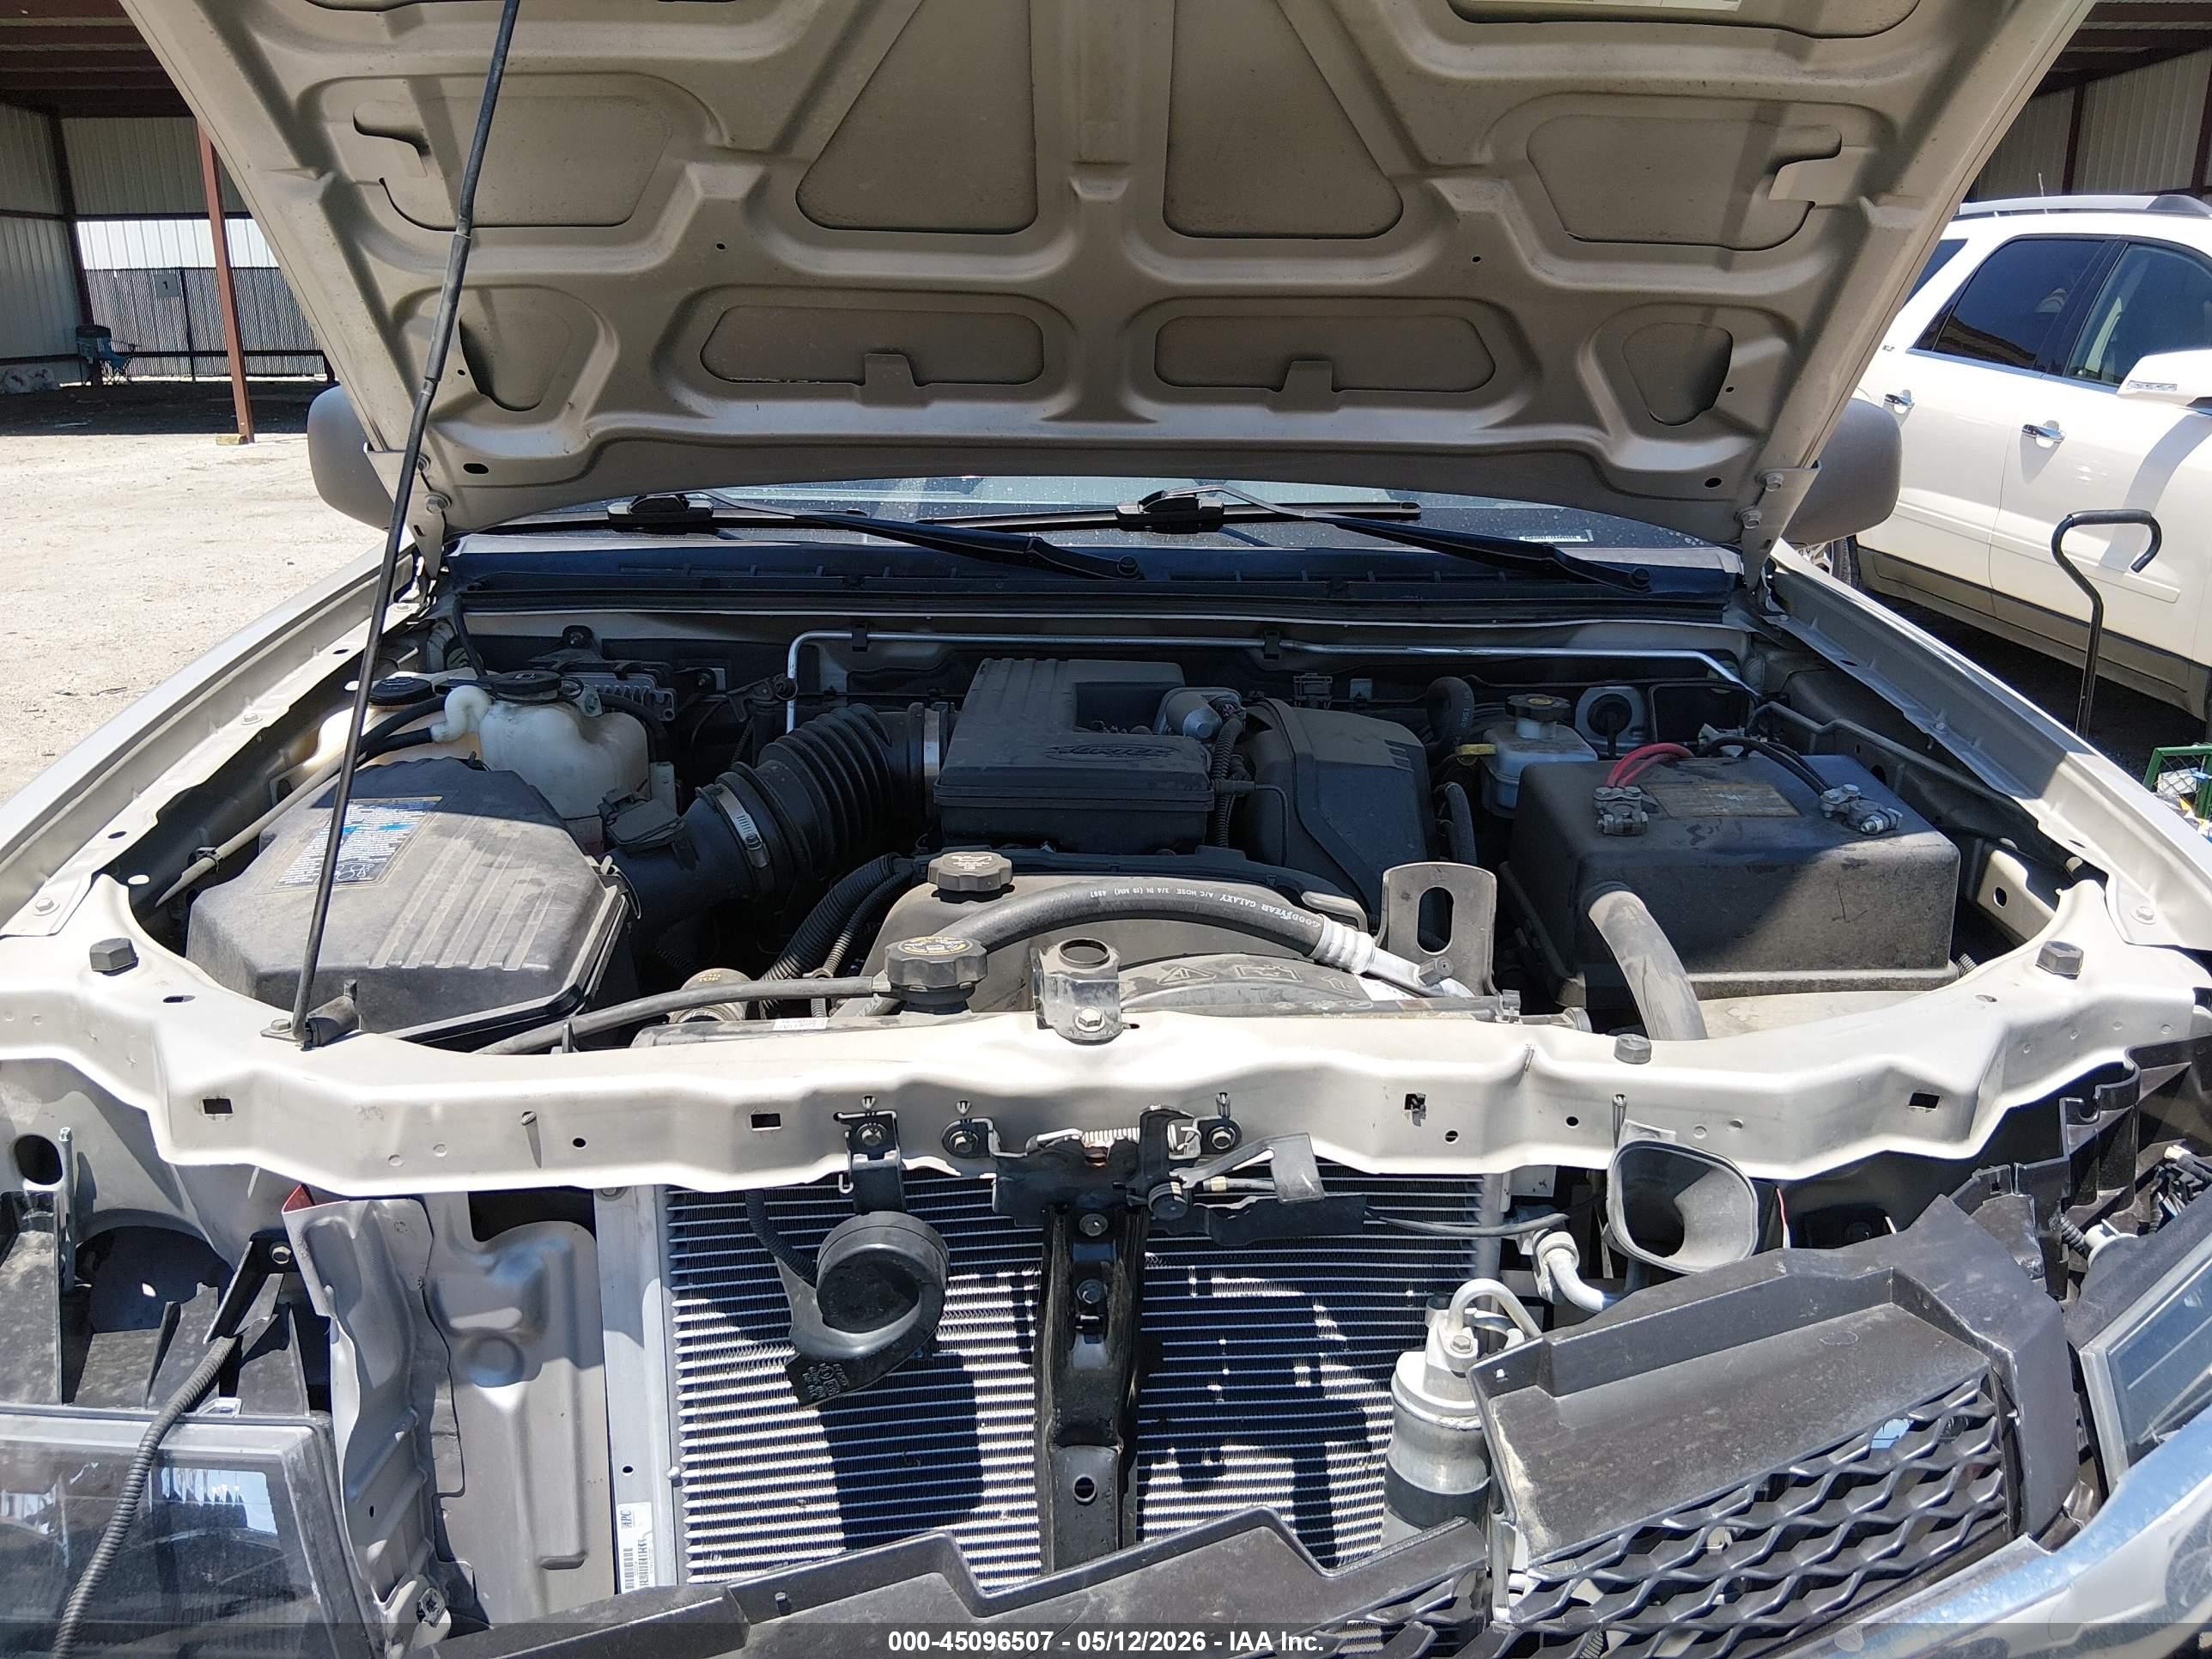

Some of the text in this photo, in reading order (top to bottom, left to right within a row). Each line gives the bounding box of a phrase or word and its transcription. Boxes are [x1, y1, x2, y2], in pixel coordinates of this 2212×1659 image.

[163, 281, 168, 289] 1
[1219, 893, 1256, 908] GALAXY
[1261, 903, 1322, 928] GOODYEAR
